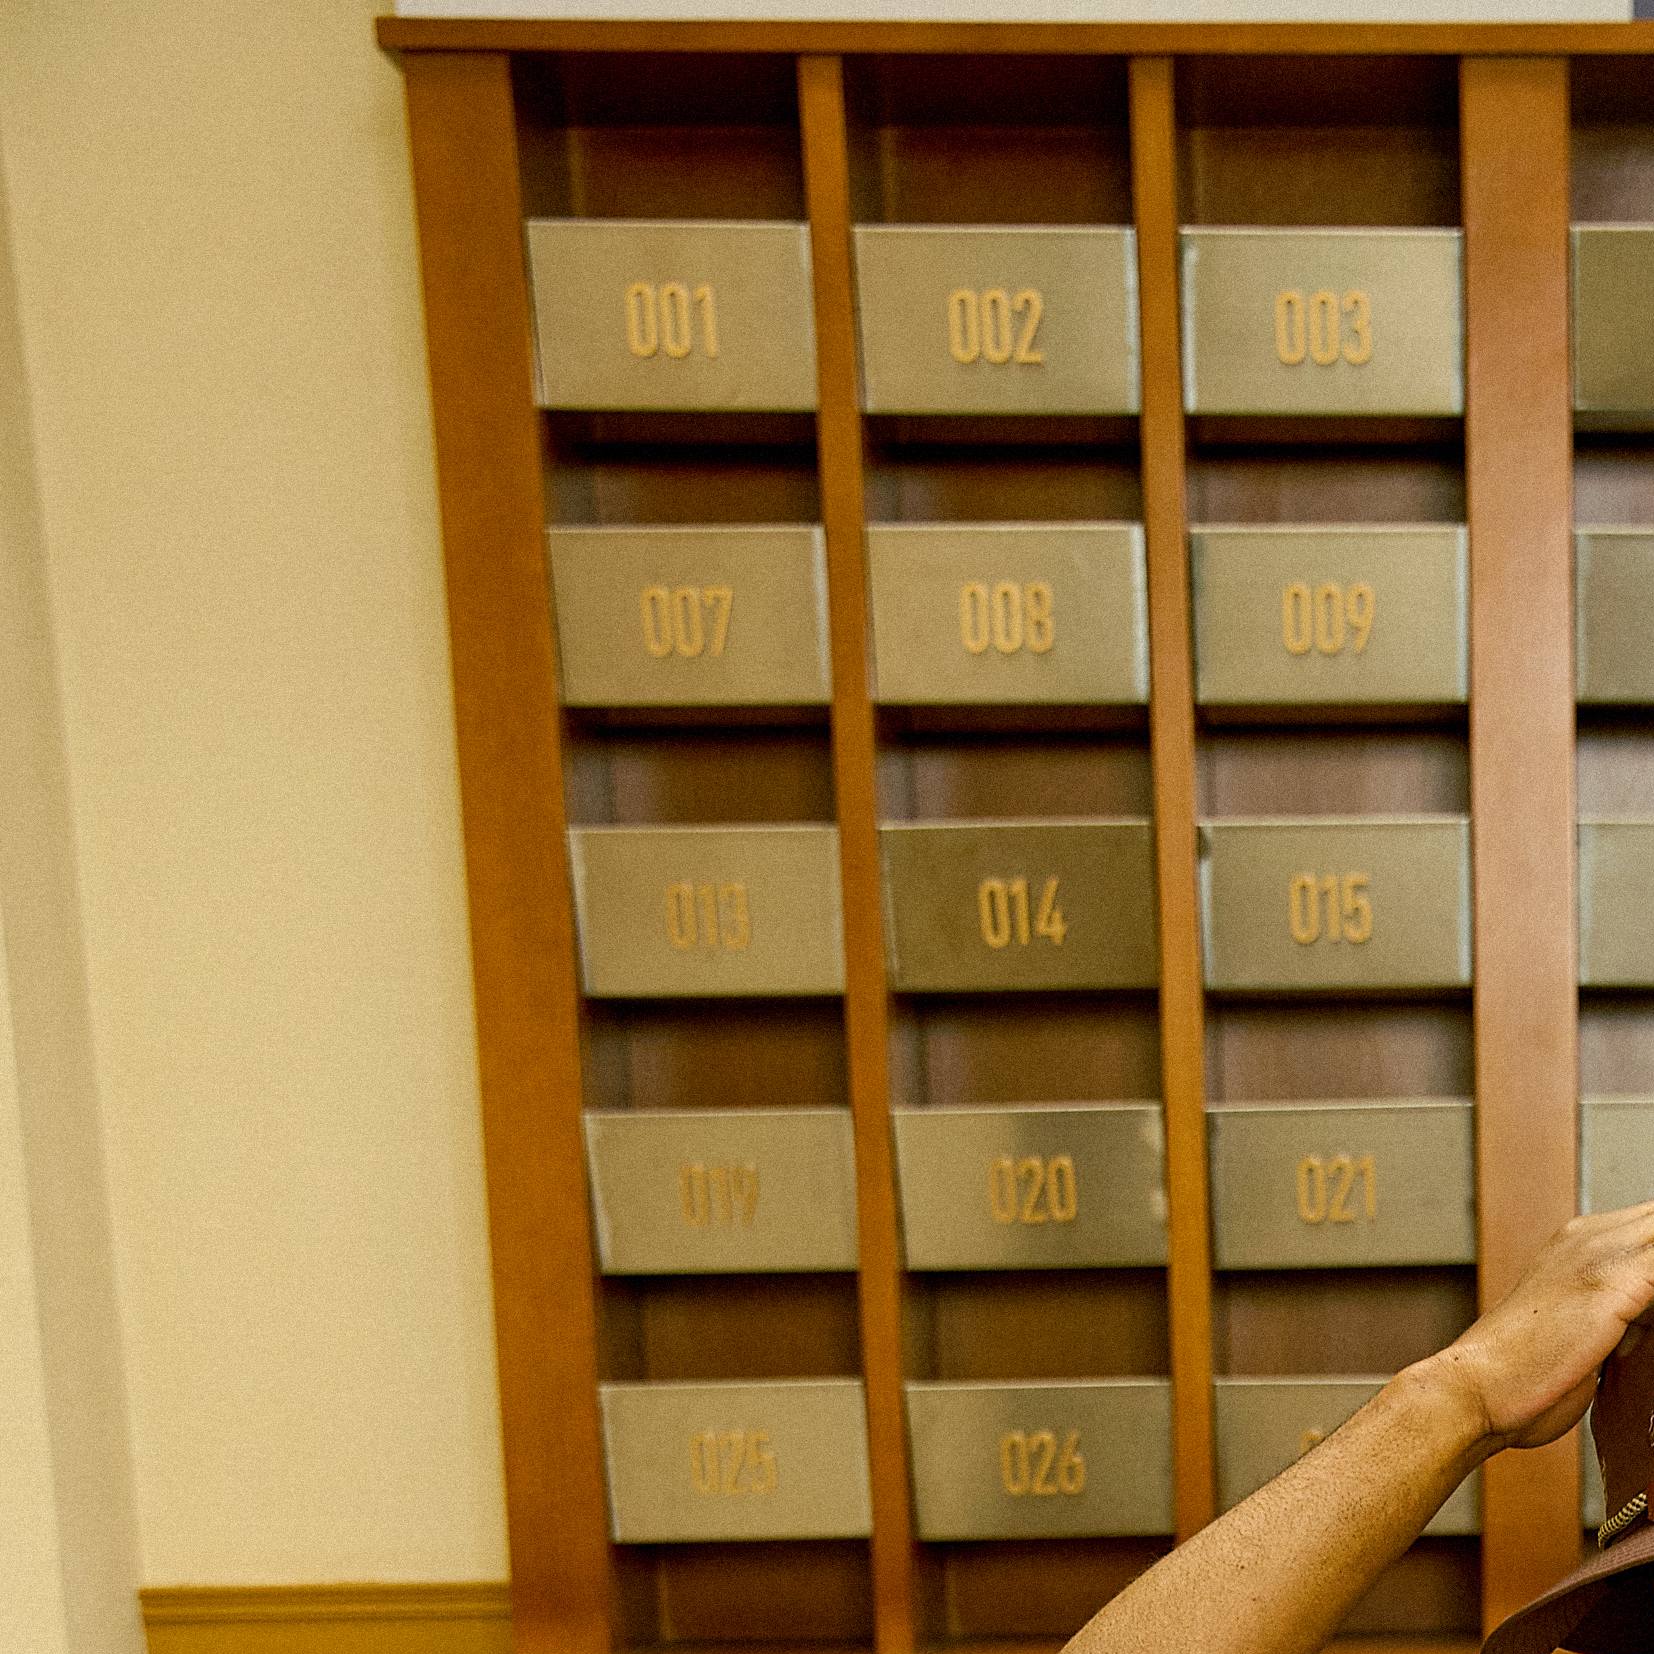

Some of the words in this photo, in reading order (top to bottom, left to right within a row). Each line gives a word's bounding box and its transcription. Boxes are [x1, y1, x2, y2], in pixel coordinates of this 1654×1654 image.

[625, 281, 719, 359] 001
[948, 288, 1044, 365] 002
[1274, 289, 1372, 366] 003
[641, 585, 733, 659] 007
[959, 581, 1055, 655] 008
[1282, 583, 1373, 656] 009
[666, 881, 750, 950] 013
[978, 877, 1066, 948] 014
[1289, 872, 1373, 944] 015
[680, 1164, 759, 1228] 019
[990, 1156, 1077, 1224] 020
[1296, 1156, 1377, 1225] 021
[691, 1432, 777, 1496] 025
[1001, 1432, 1085, 1496] 026
